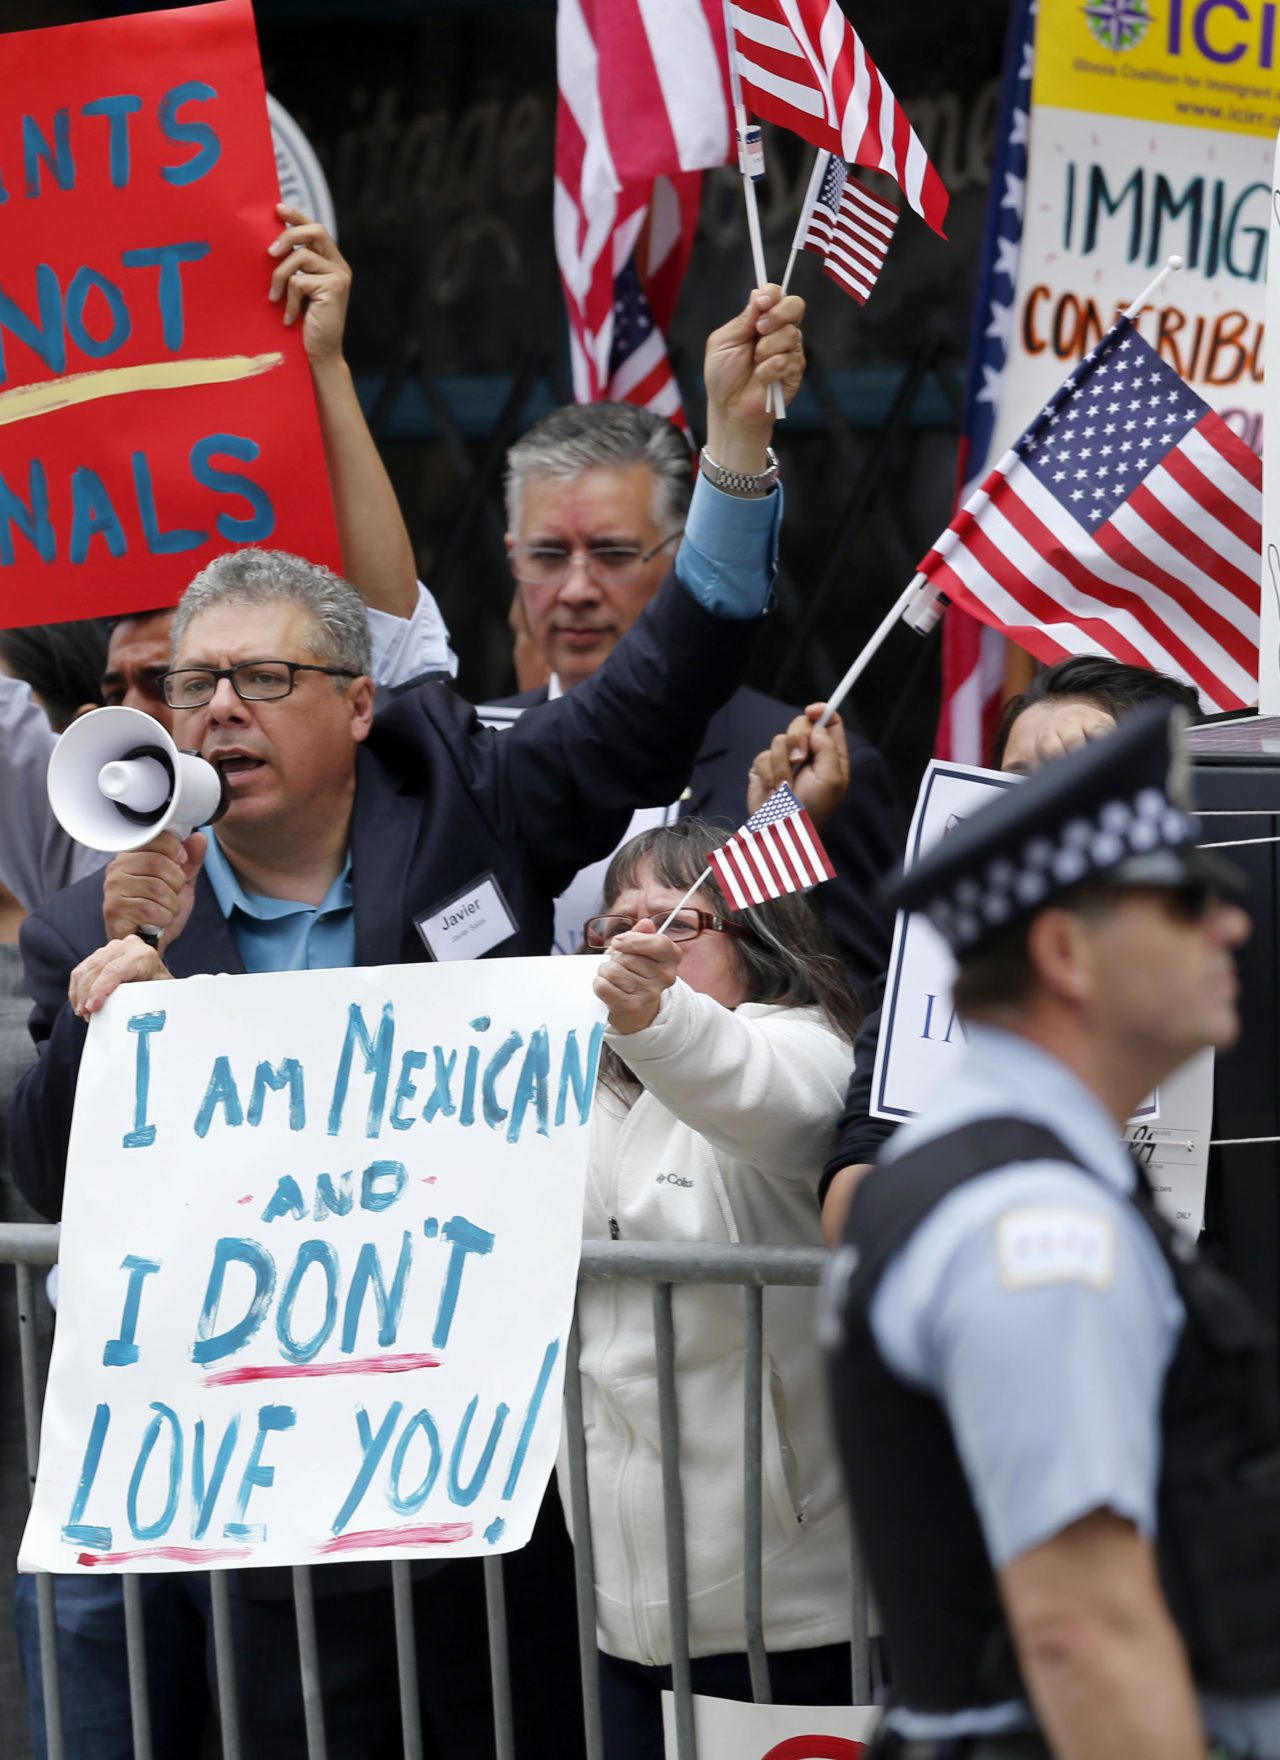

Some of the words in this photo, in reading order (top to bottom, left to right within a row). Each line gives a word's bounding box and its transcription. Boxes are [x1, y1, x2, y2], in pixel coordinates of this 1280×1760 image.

[1063, 160, 1271, 284] IMMIG
[441, 899, 481, 931] Javier
[122, 1009, 166, 1149] I
[260, 1160, 409, 1223] AND
[102, 1254, 163, 1367] I
[190, 1215, 496, 1370] DON'T
[60, 1401, 298, 1546] LOVE
[329, 1335, 561, 1545] YOU!
